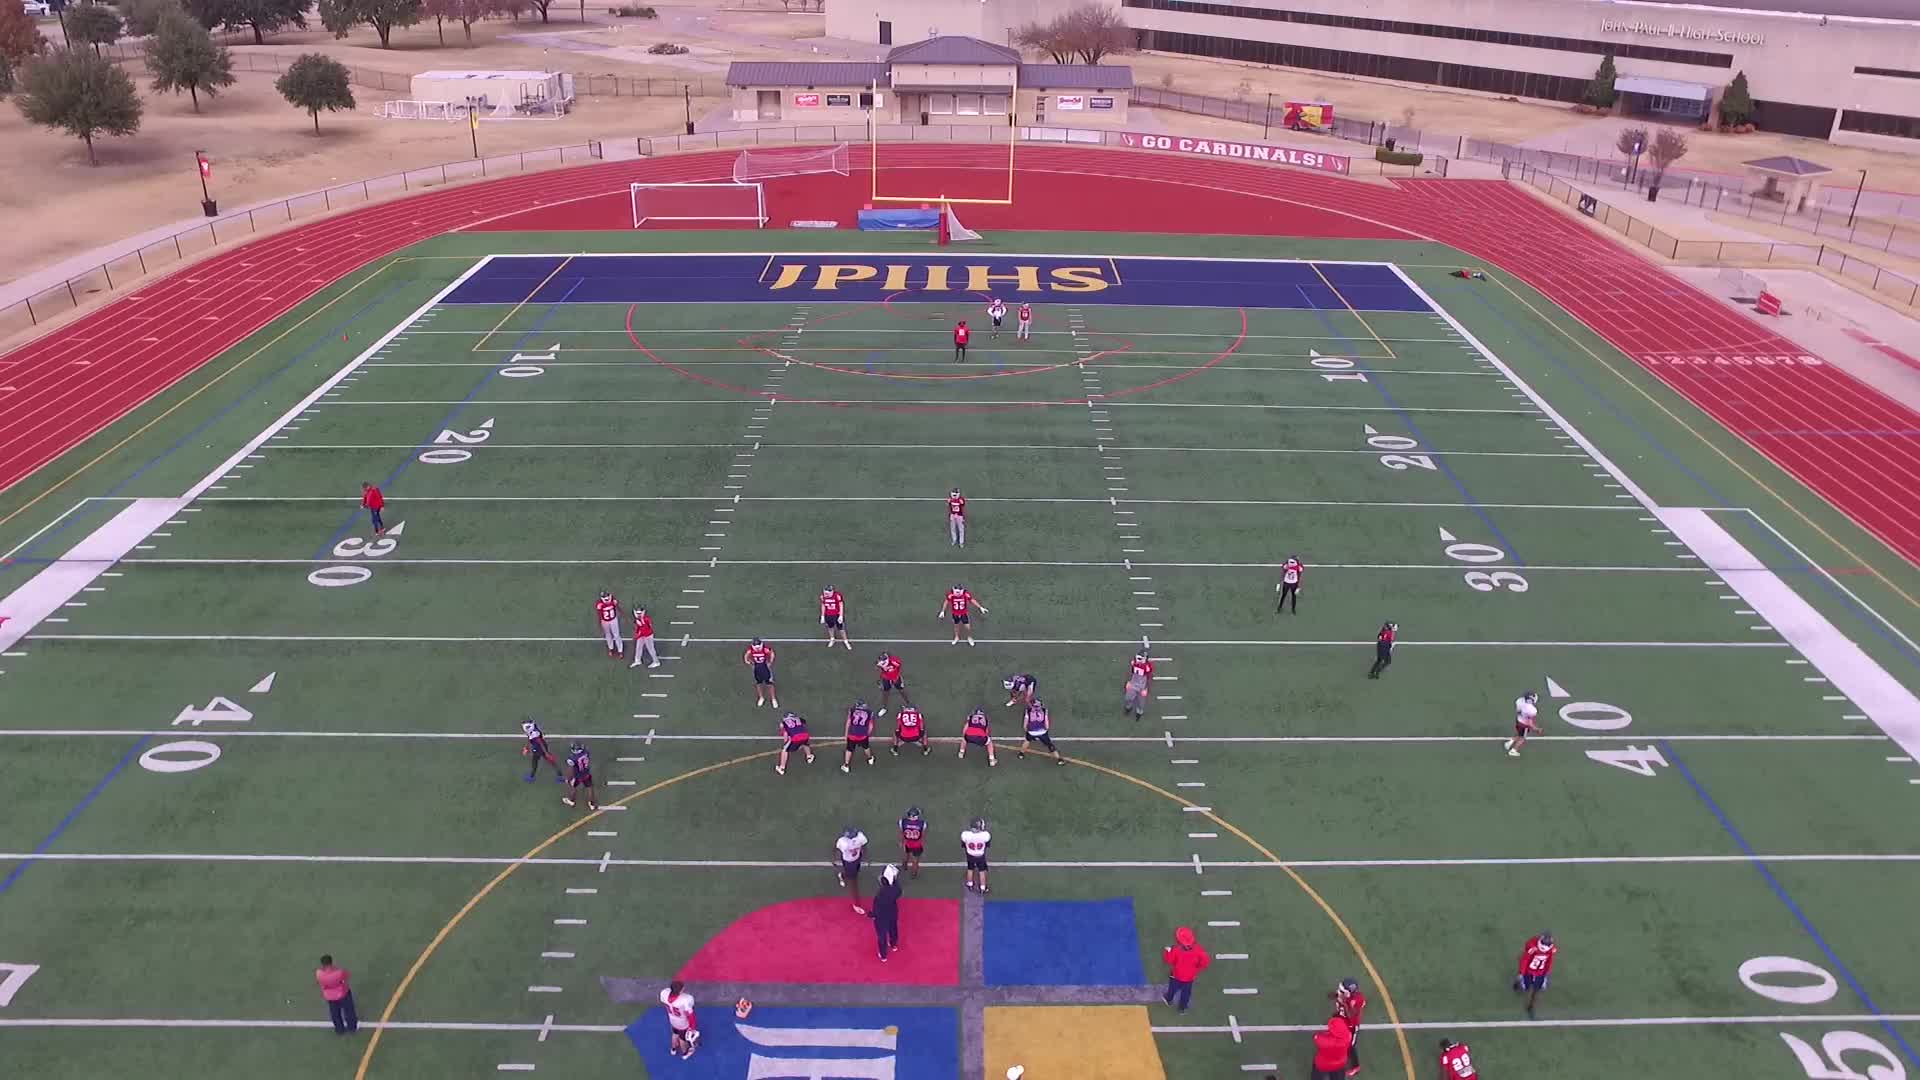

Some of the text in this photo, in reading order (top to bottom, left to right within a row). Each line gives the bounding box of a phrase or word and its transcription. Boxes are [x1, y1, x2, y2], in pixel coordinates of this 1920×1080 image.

[1142, 135, 1324, 168] GO CARDINALS!
[769, 264, 1108, 292] JPIIHS
[499, 352, 556, 378] 10
[1310, 357, 1368, 383] 10
[418, 429, 490, 464] 20
[1367, 435, 1437, 470] 20
[307, 537, 397, 587] 30
[1445, 543, 1529, 593] 30
[138, 696, 254, 773] 40
[1558, 701, 1669, 777] 40
